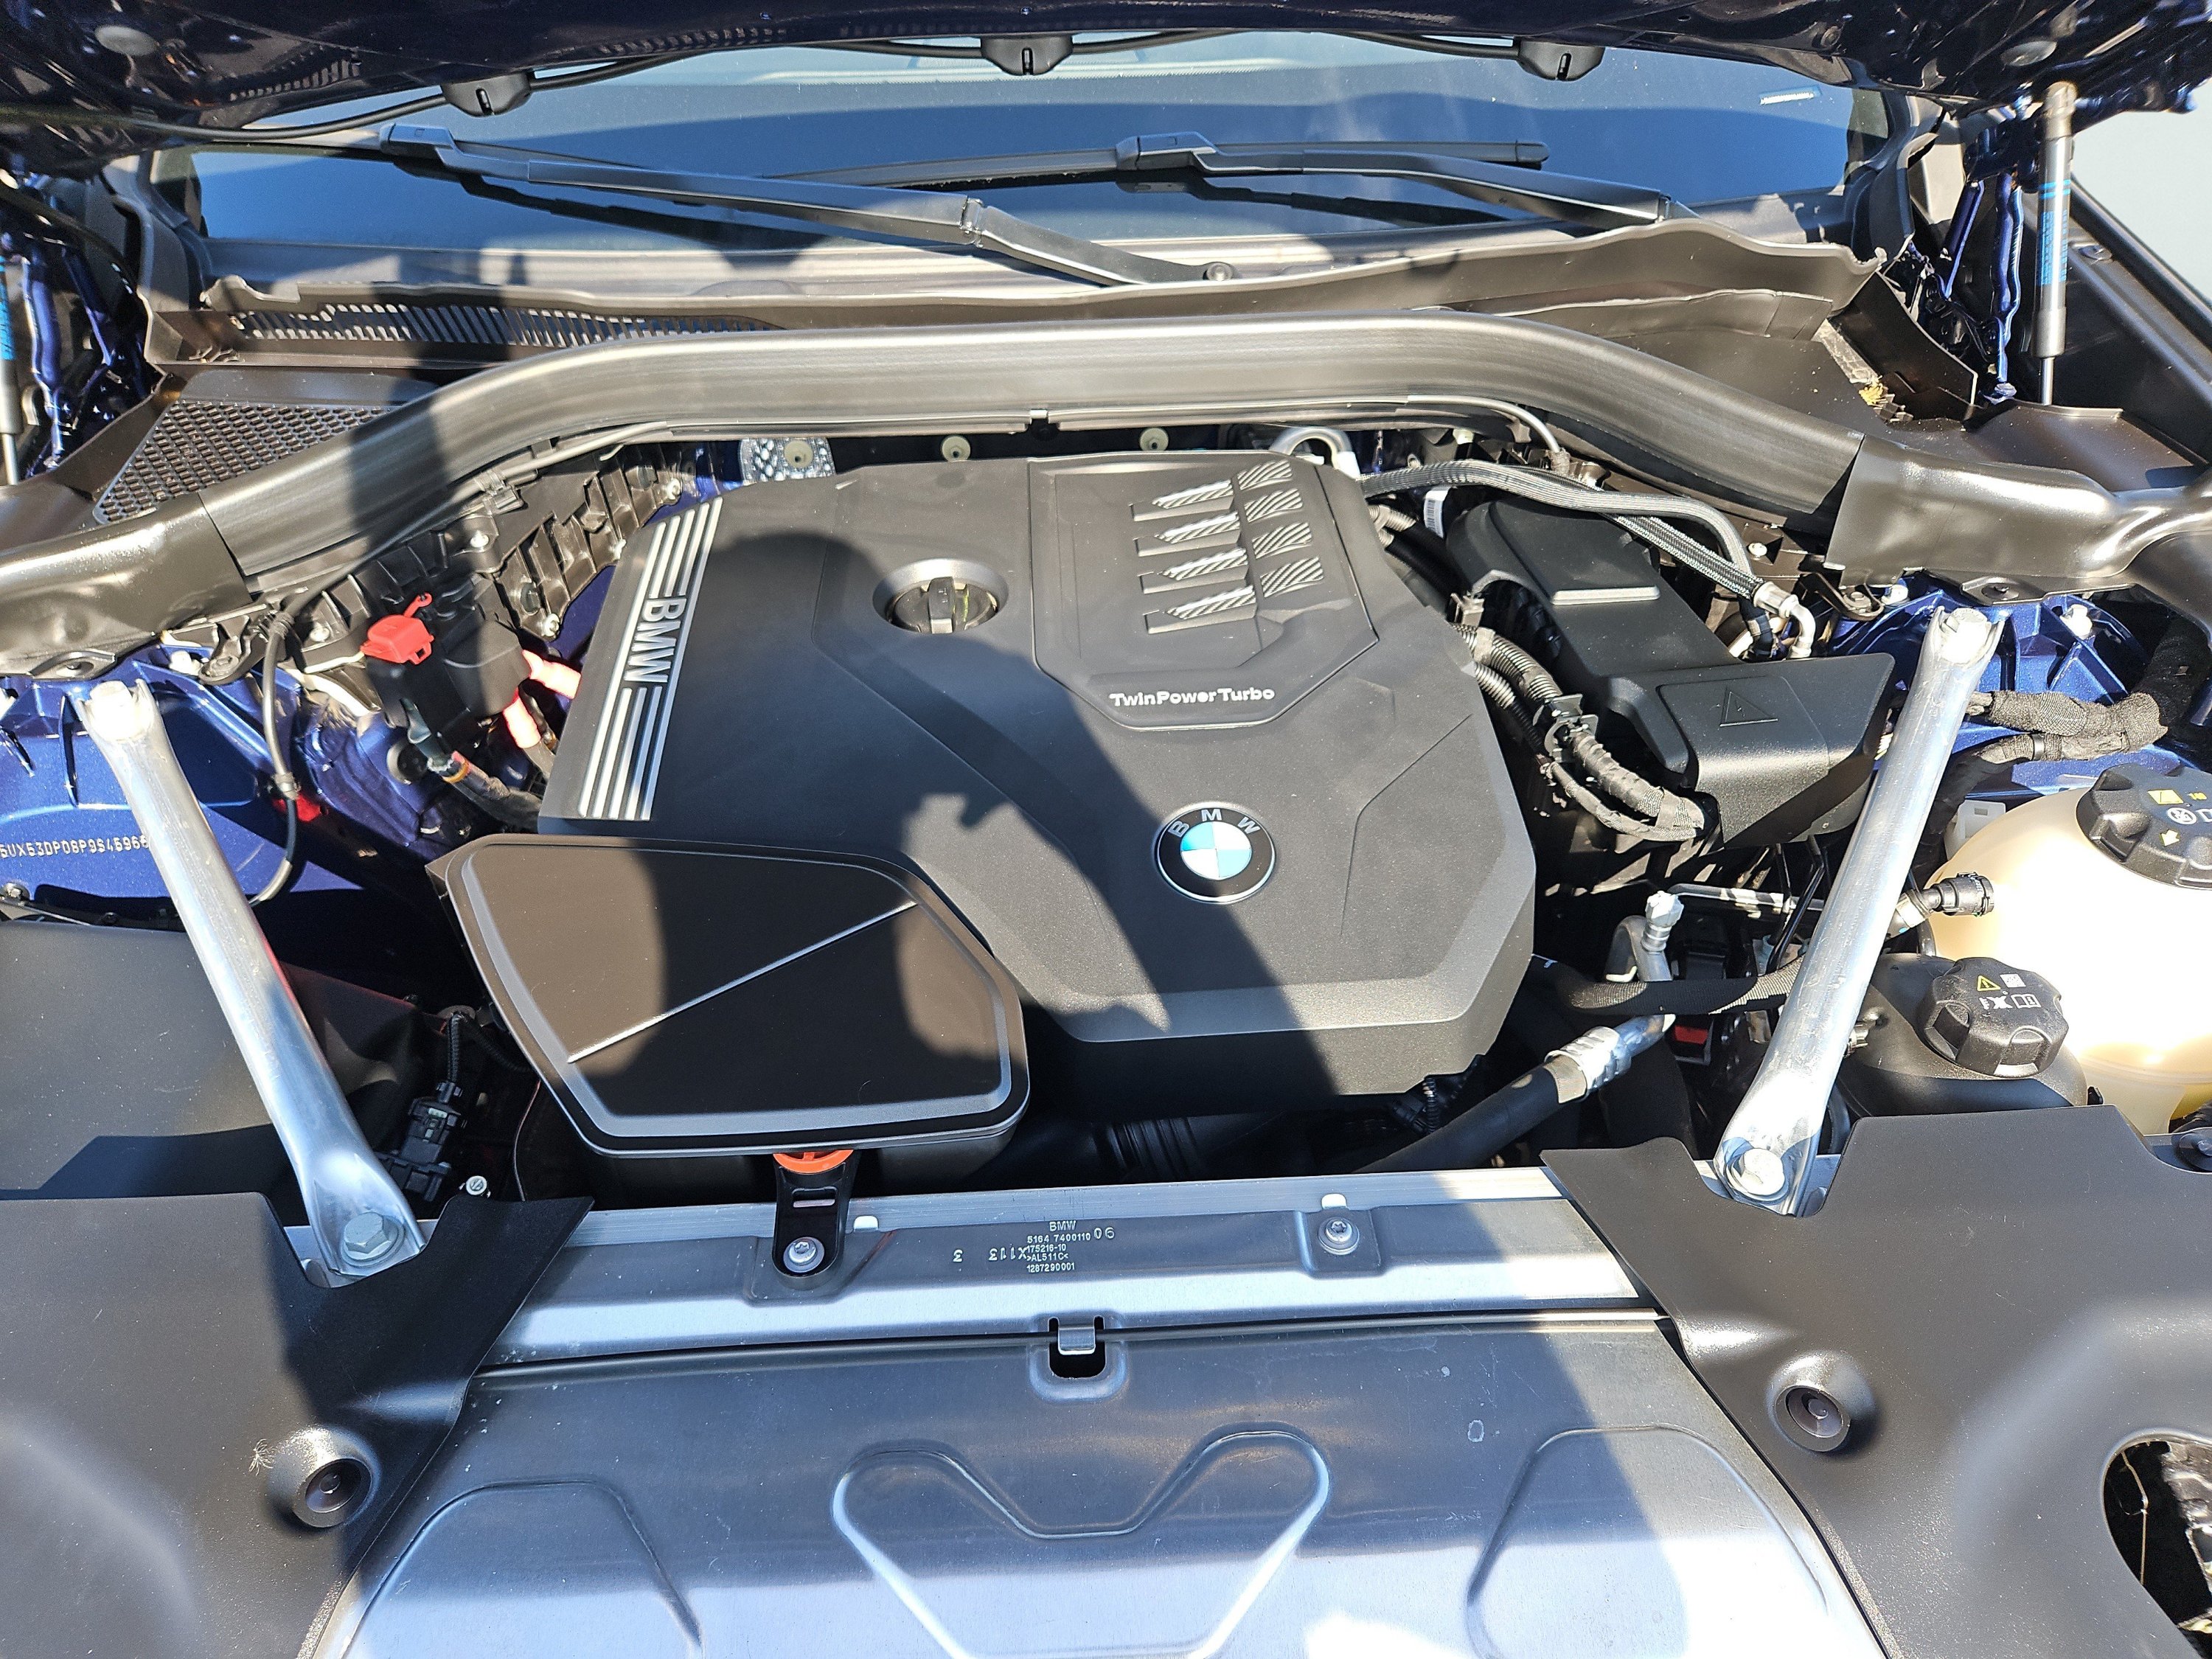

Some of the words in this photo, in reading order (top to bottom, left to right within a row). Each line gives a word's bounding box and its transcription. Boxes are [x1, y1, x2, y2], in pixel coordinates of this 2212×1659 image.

[624, 599, 688, 684] BMW
[1167, 808, 1261, 838] BMW
[1049, 1220, 1077, 1232] BMW
[1027, 1234, 1050, 1244] 5164
[1054, 1232, 1091, 1242] 7400110
[1026, 1243, 1067, 1253] 175216-10
[1026, 1262, 1075, 1273] 1287290001
